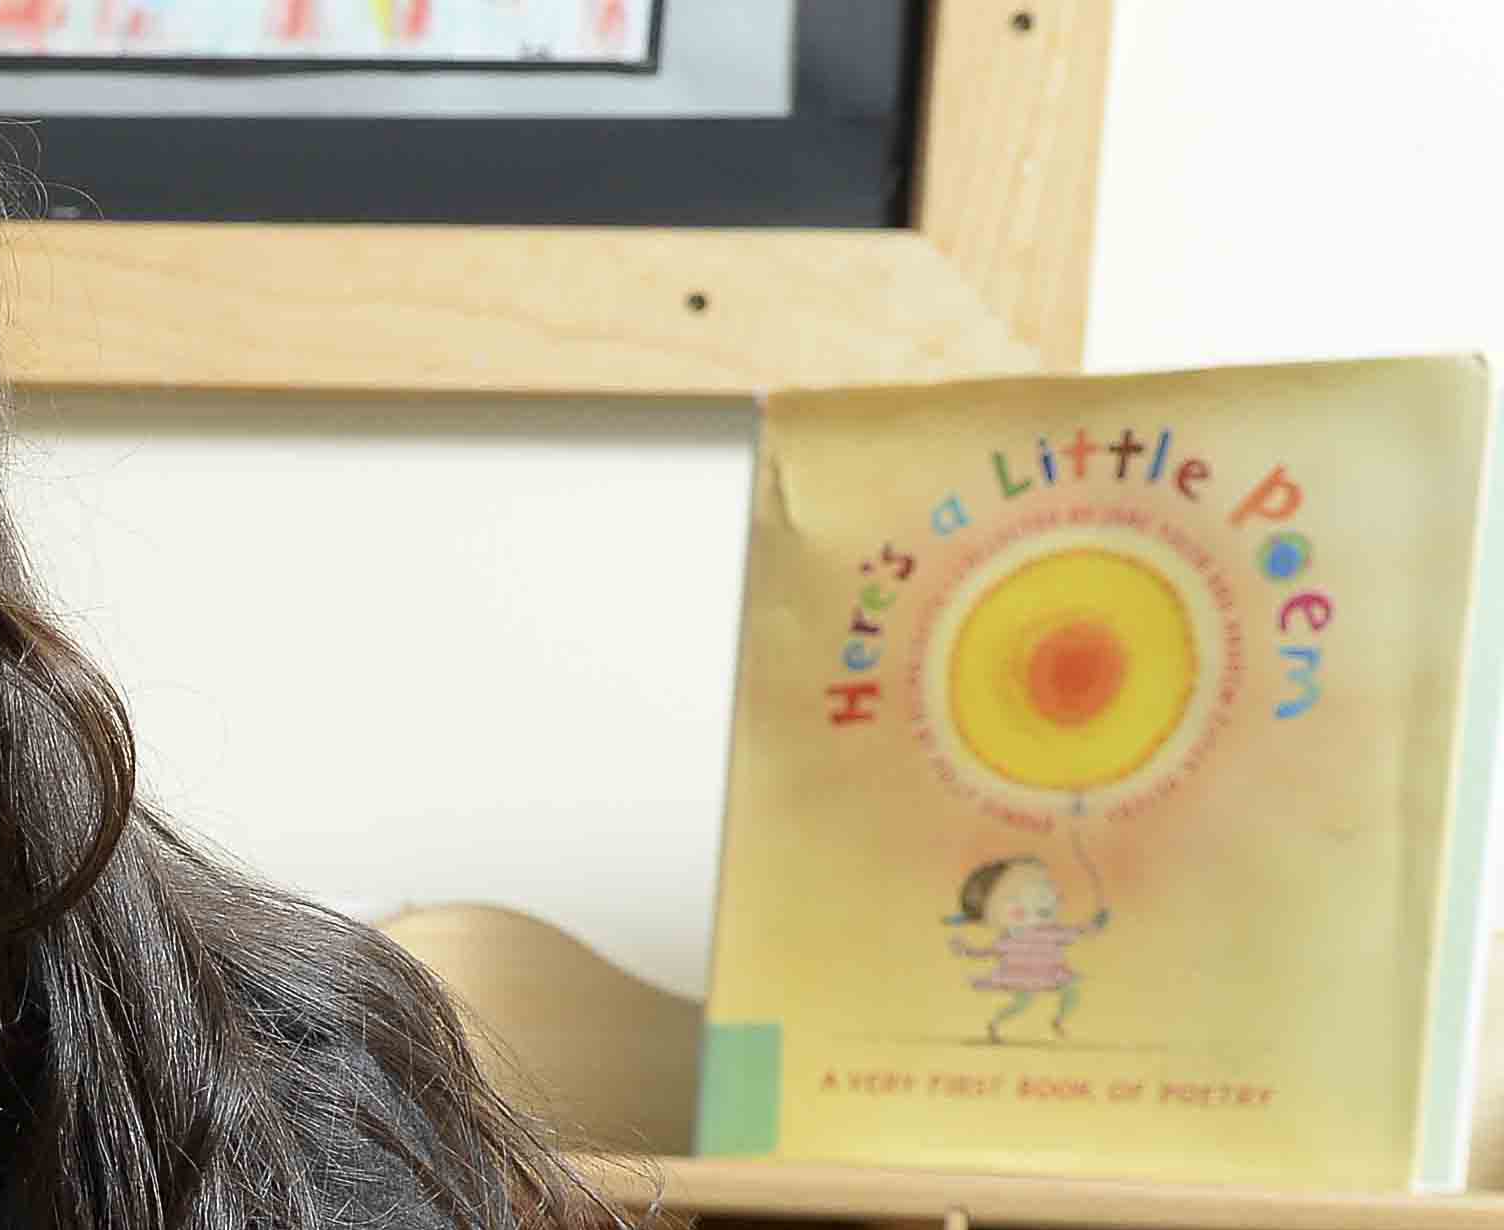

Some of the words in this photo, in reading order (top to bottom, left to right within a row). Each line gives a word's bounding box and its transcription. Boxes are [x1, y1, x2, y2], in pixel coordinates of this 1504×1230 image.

[929, 491, 974, 542] a
[992, 428, 1212, 502] Little
[847, 1071, 917, 1096] VERY
[928, 1072, 1002, 1099] FIRST
[1016, 1075, 1090, 1102] BOOK
[1159, 1080, 1278, 1107] POETRY
